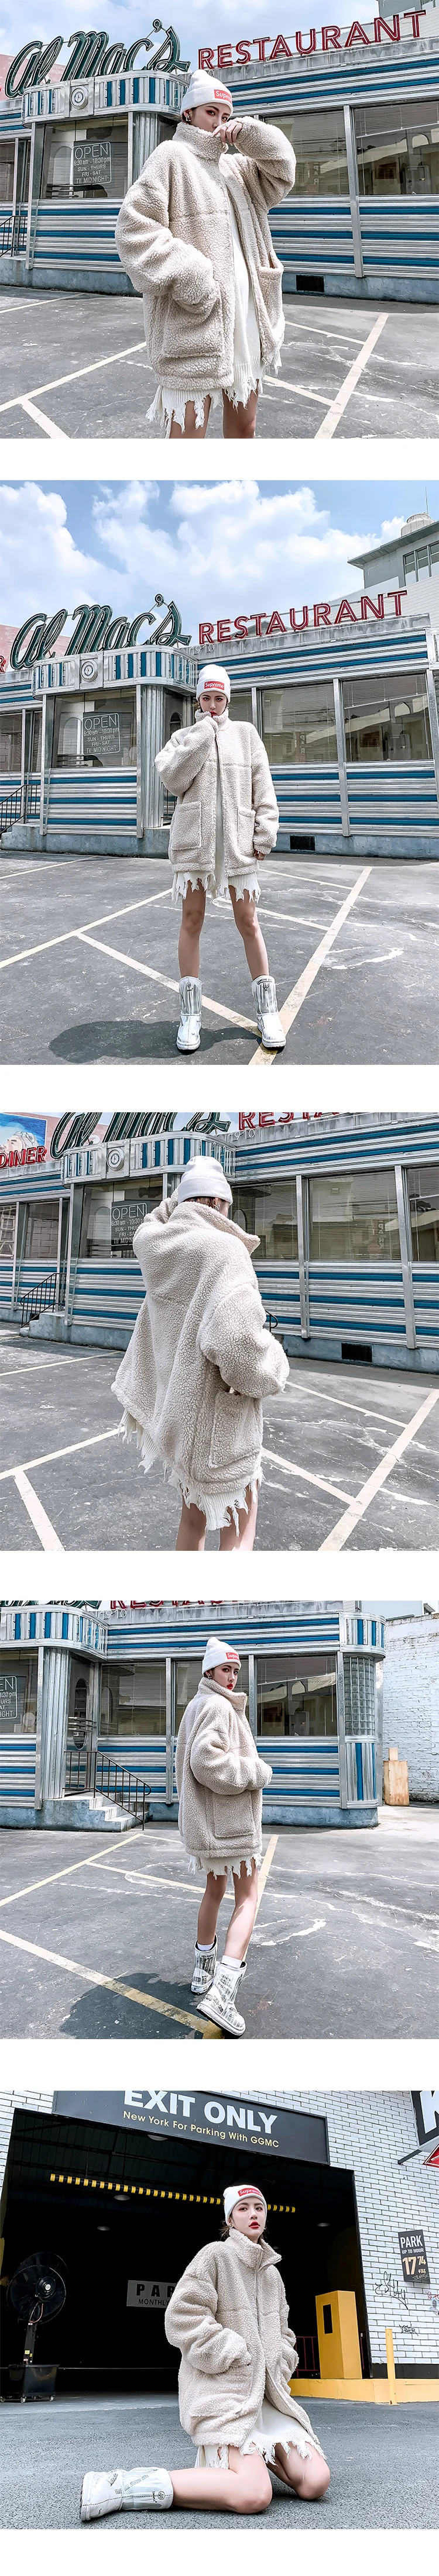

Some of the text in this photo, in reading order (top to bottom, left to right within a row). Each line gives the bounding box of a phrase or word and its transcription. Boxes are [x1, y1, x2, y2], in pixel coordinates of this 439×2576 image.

[198, 9, 427, 70] RESTAURANT
[75, 143, 108, 160] OPEN
[198, 589, 407, 644] RESTAURANT
[190, 643, 214, 655] 1910
[84, 714, 117, 730] OPEN
[228, 1129, 255, 1141] 1910
[0, 1146, 46, 1168] DINER
[112, 1205, 145, 1220] OPEN
[100, 1609, 126, 1619] 1910
[124, 2091, 277, 2134] EXIT ONLY
[123, 2111, 279, 2147] New York For Parking With GGMC
[400, 2235, 423, 2248] PARK
[402, 2256, 417, 2275] 17
